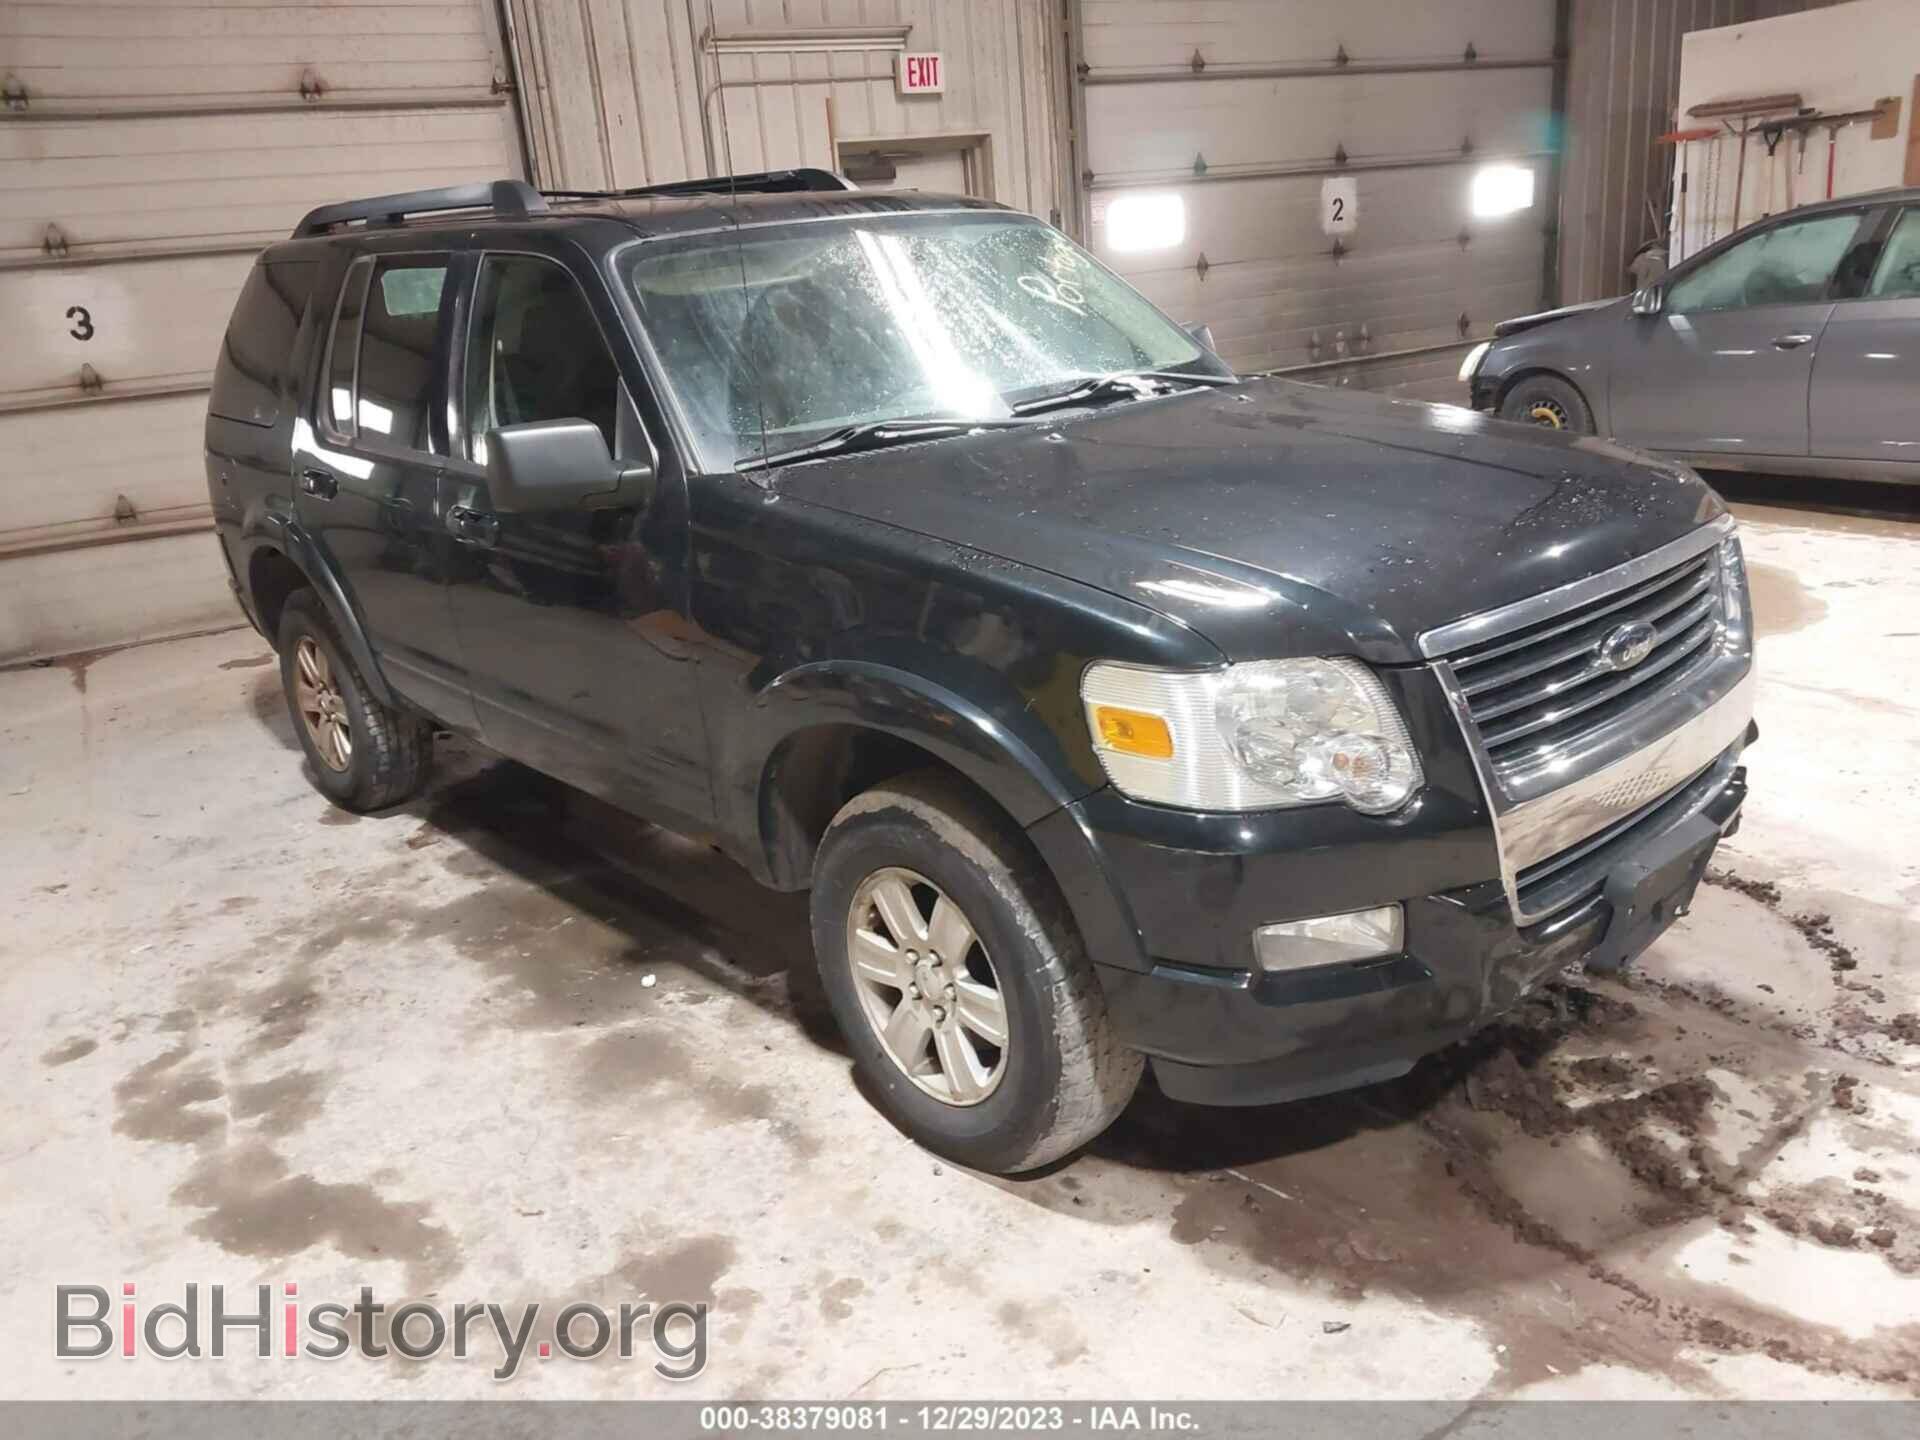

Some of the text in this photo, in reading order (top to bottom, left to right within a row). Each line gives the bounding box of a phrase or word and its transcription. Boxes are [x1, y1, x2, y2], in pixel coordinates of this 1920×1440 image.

[907, 57, 938, 87] EXIT
[1332, 197, 1344, 222] 2
[66, 306, 94, 341] 3
